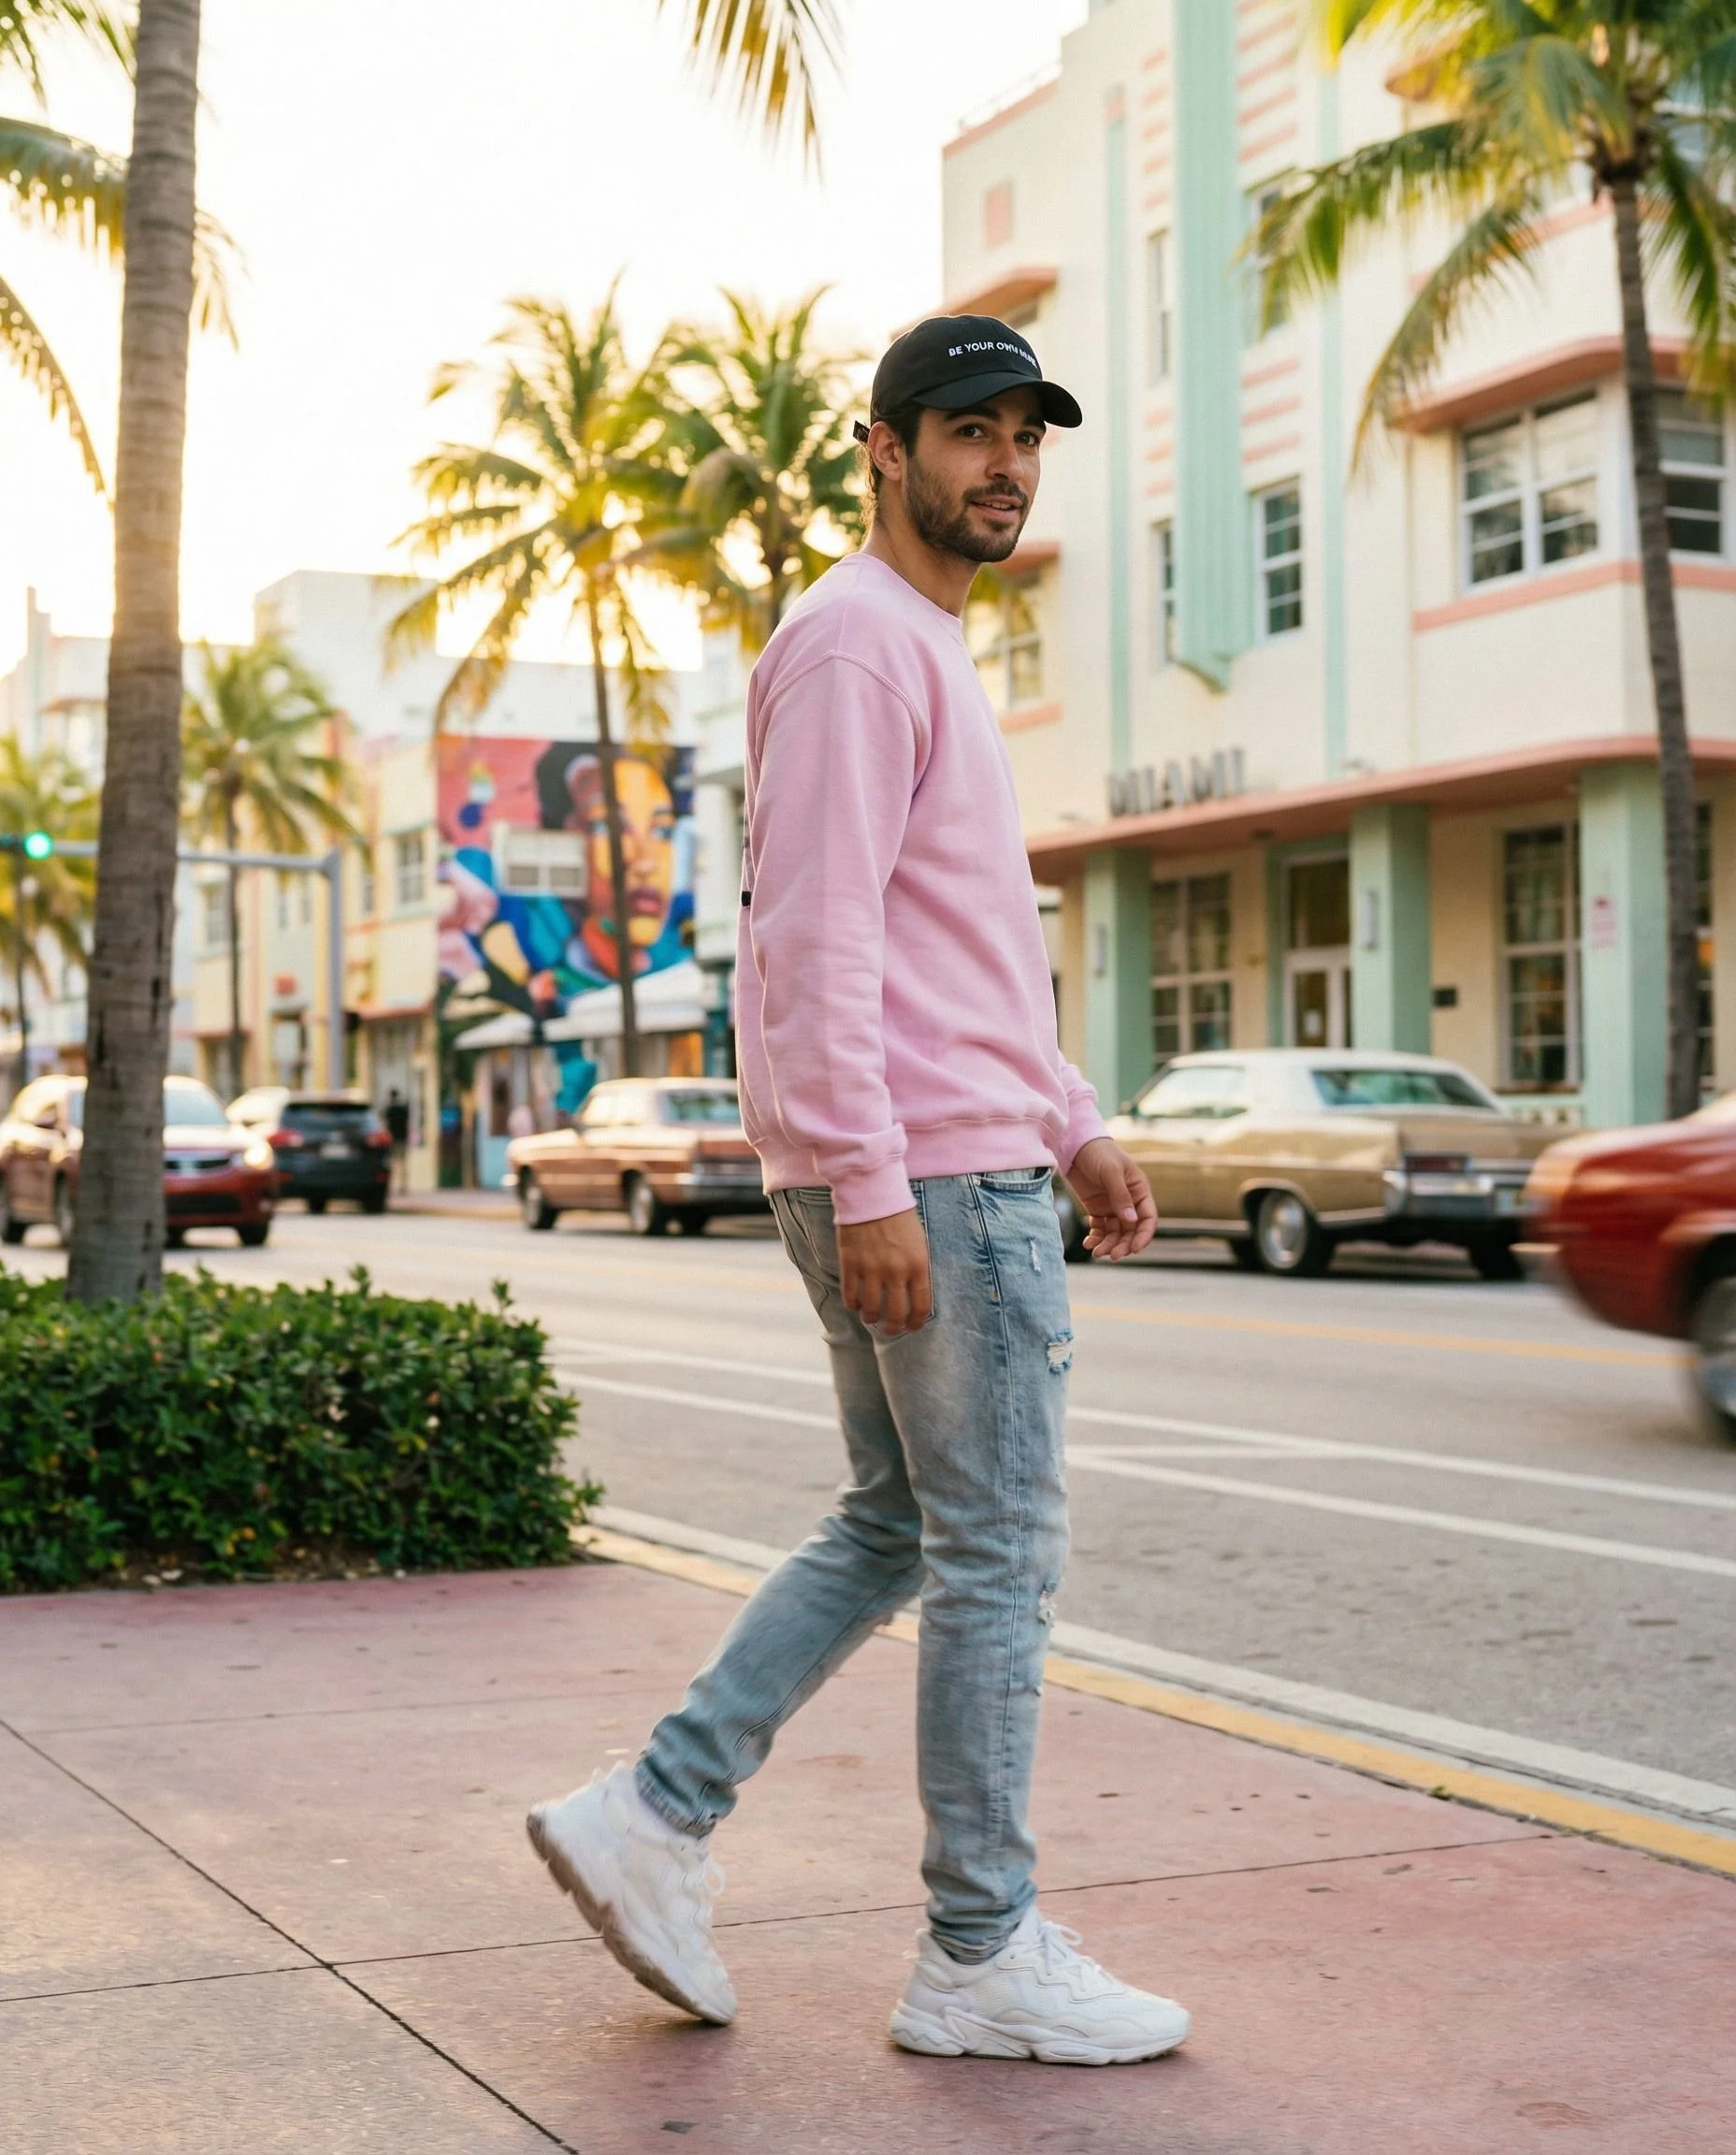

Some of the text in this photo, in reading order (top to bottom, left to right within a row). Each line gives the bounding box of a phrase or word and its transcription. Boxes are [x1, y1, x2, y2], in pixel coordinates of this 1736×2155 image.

[948, 341, 1018, 356] BE YOUR OWN
[1108, 749, 1244, 817] MIAMI
